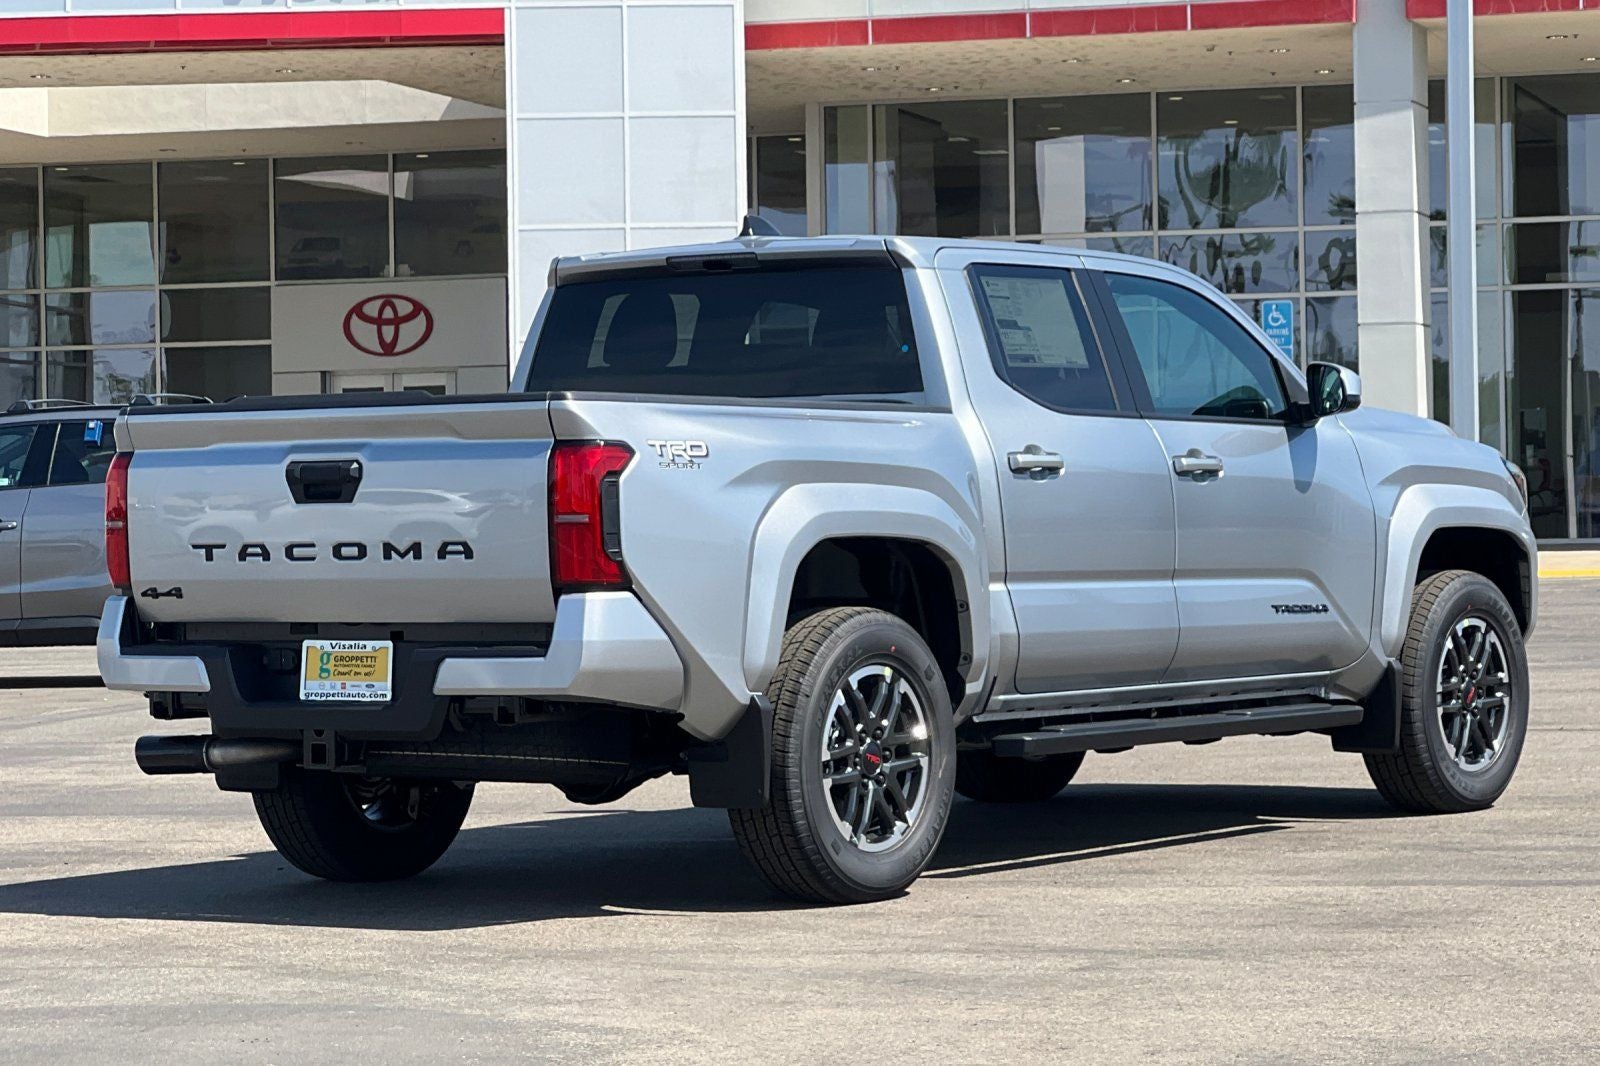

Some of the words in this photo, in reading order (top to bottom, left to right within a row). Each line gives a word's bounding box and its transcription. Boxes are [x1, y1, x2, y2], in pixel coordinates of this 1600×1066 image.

[647, 440, 708, 462] TRD
[659, 462, 702, 470] SPORT
[191, 540, 475, 562] TACOMA
[1271, 604, 1330, 614] TACOMA
[330, 642, 367, 650] Visalia
[333, 655, 377, 663] GROPPETTI
[304, 691, 388, 699] groppettiauto.com
